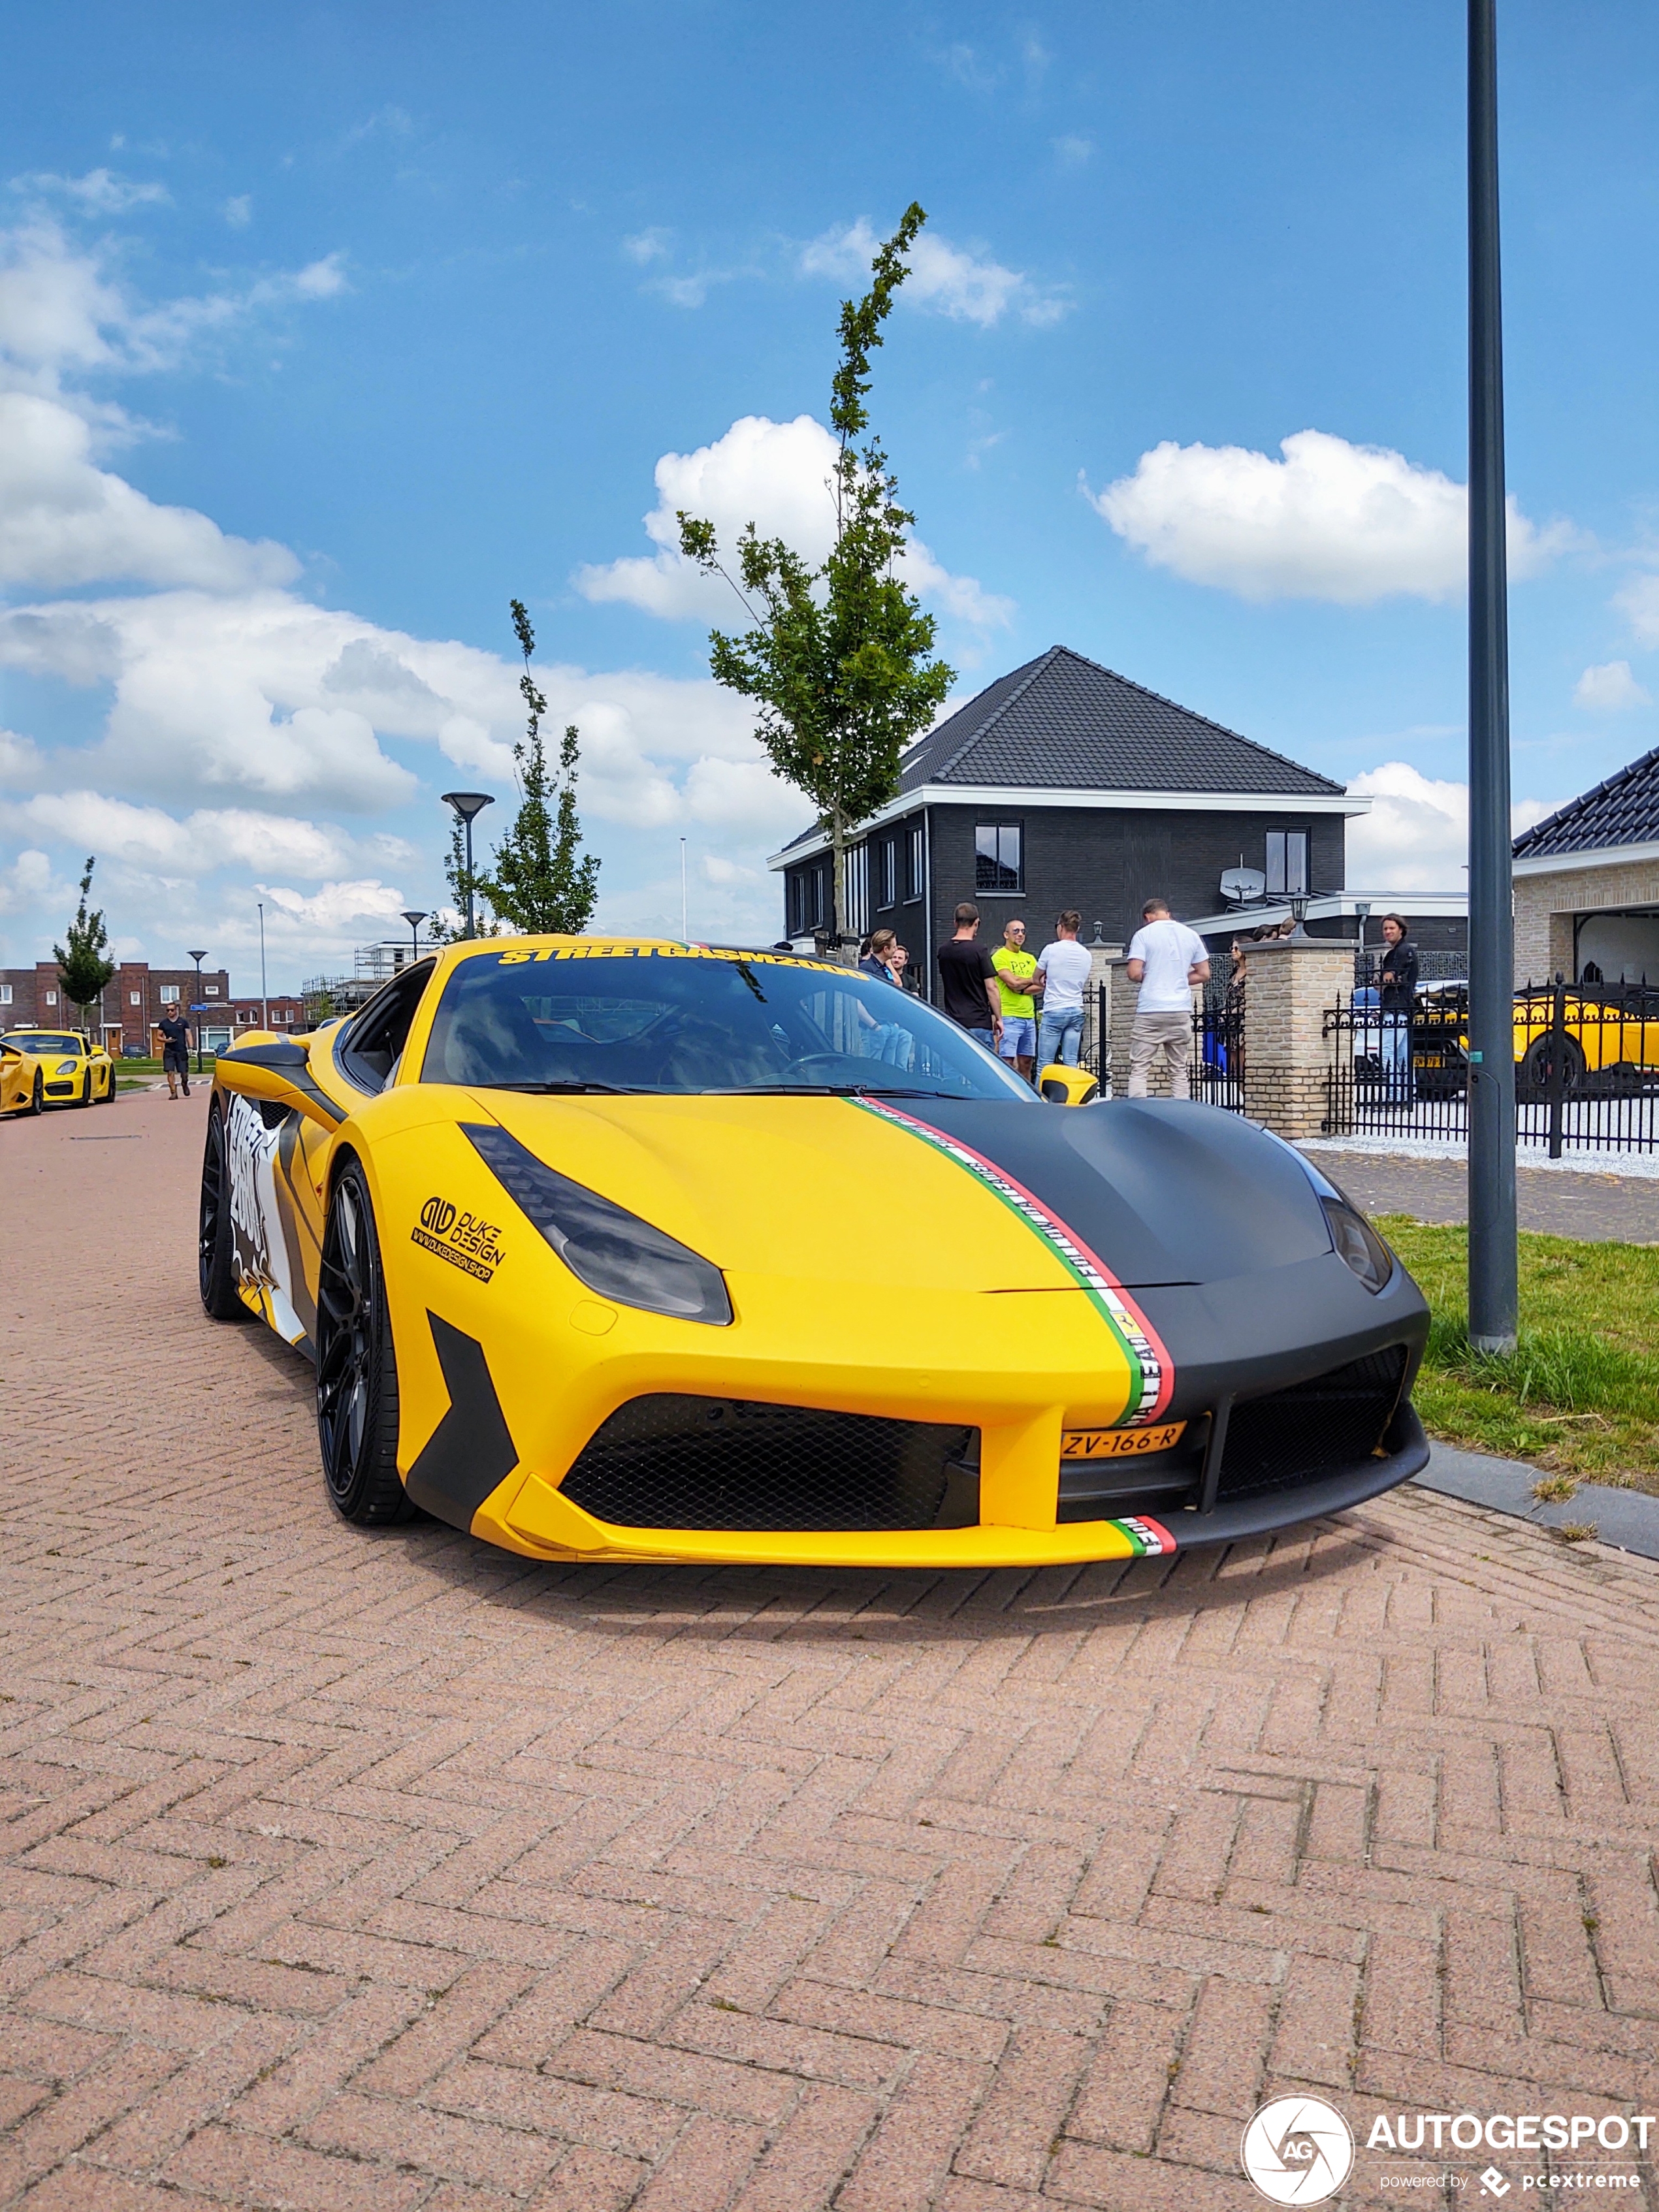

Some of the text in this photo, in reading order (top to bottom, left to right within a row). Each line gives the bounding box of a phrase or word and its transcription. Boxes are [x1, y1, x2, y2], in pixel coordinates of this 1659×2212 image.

[498, 946, 870, 980] STREETGASM2000
[458, 1211, 502, 1243] DUKE
[413, 1228, 491, 1279] WWW.DUKEDESIGN.SHOP
[449, 1226, 506, 1266] DESIGN
[1063, 1427, 1176, 1454] ZV-166-R
